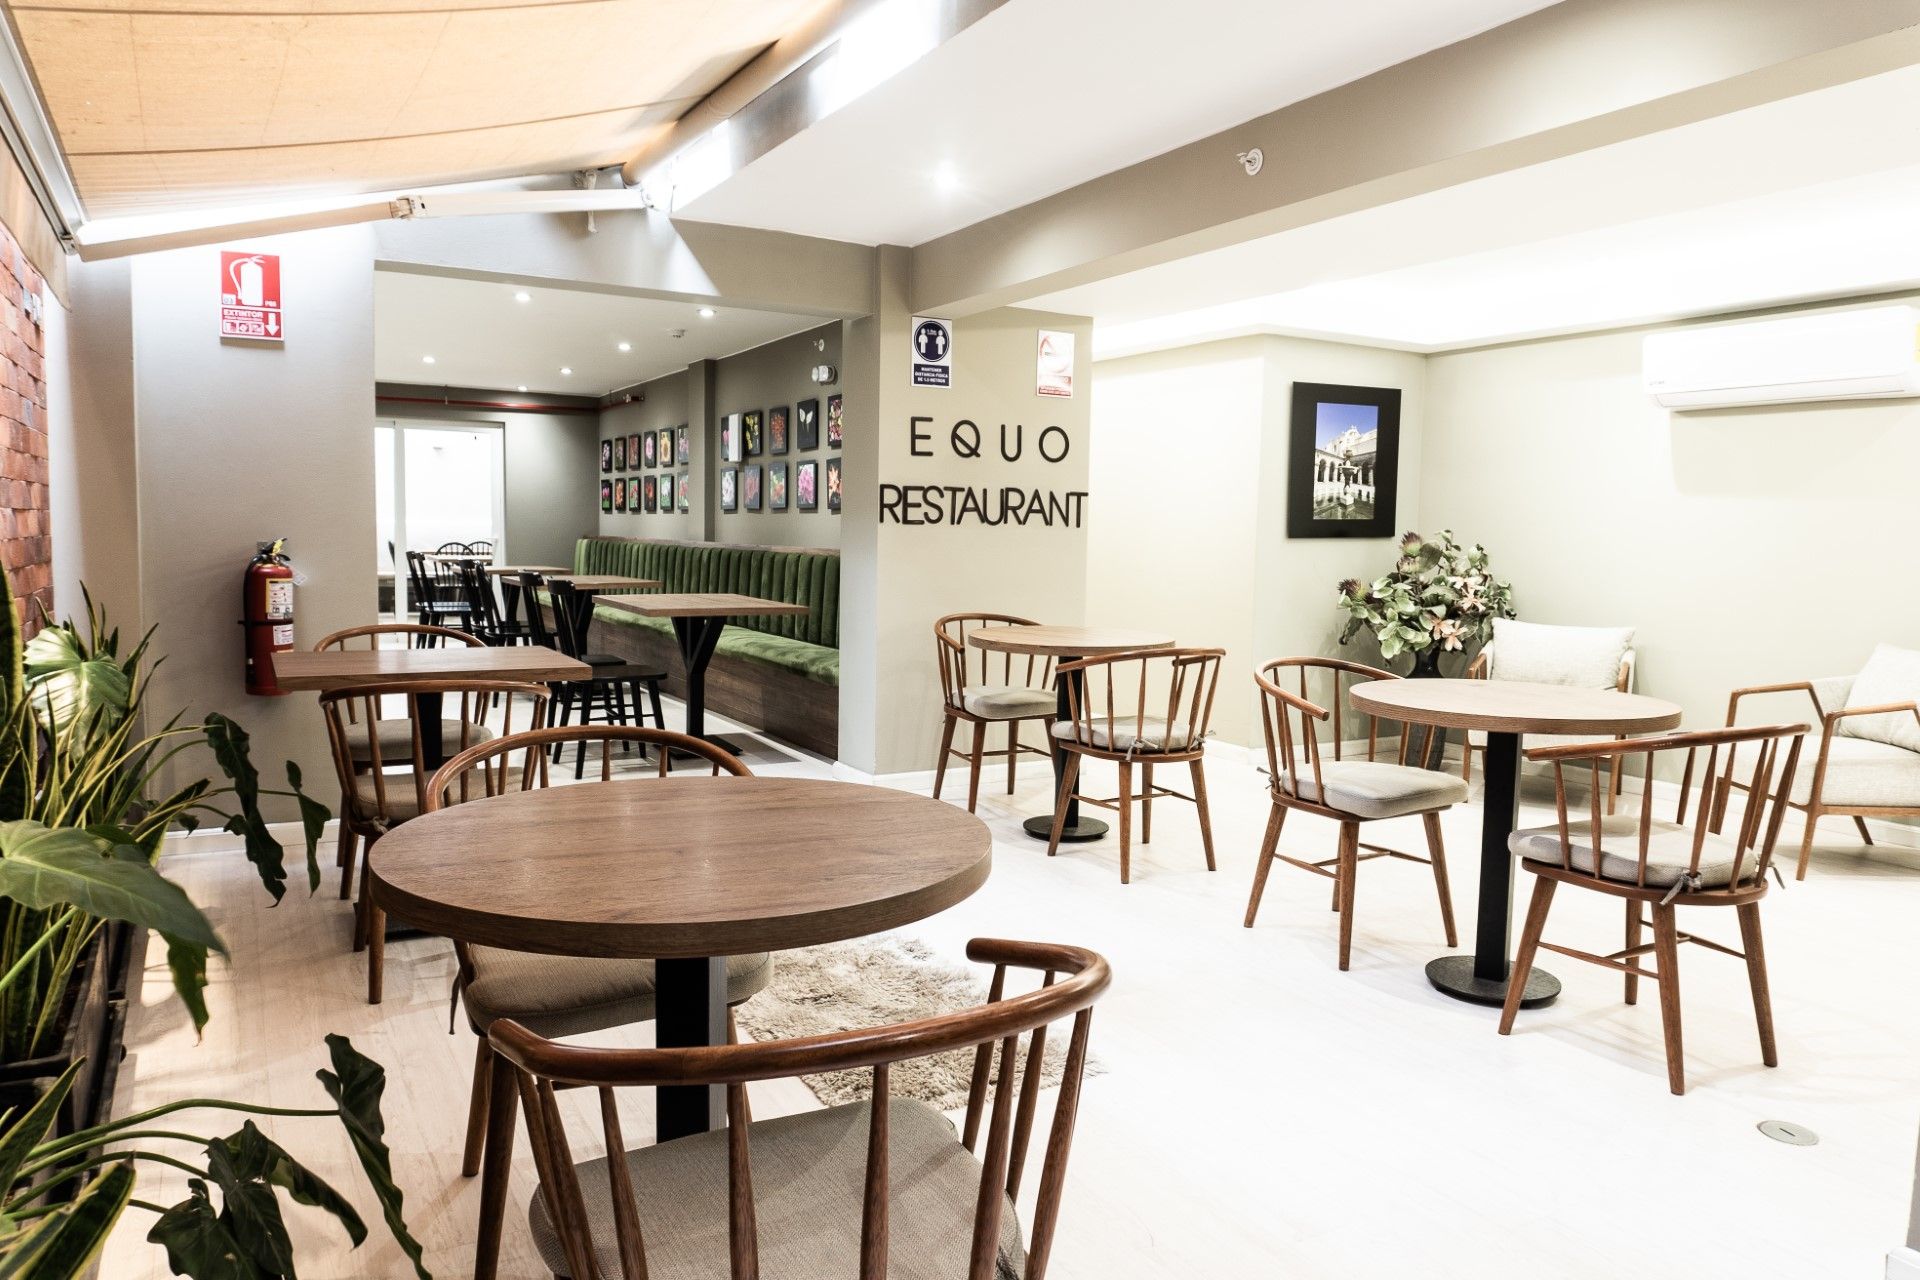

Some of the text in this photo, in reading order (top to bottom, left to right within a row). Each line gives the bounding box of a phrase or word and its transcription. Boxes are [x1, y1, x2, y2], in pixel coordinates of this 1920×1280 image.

[223, 309, 263, 318] EXTINTOR
[910, 416, 1070, 463] EQUO
[879, 484, 1089, 528] RESTAURANT
